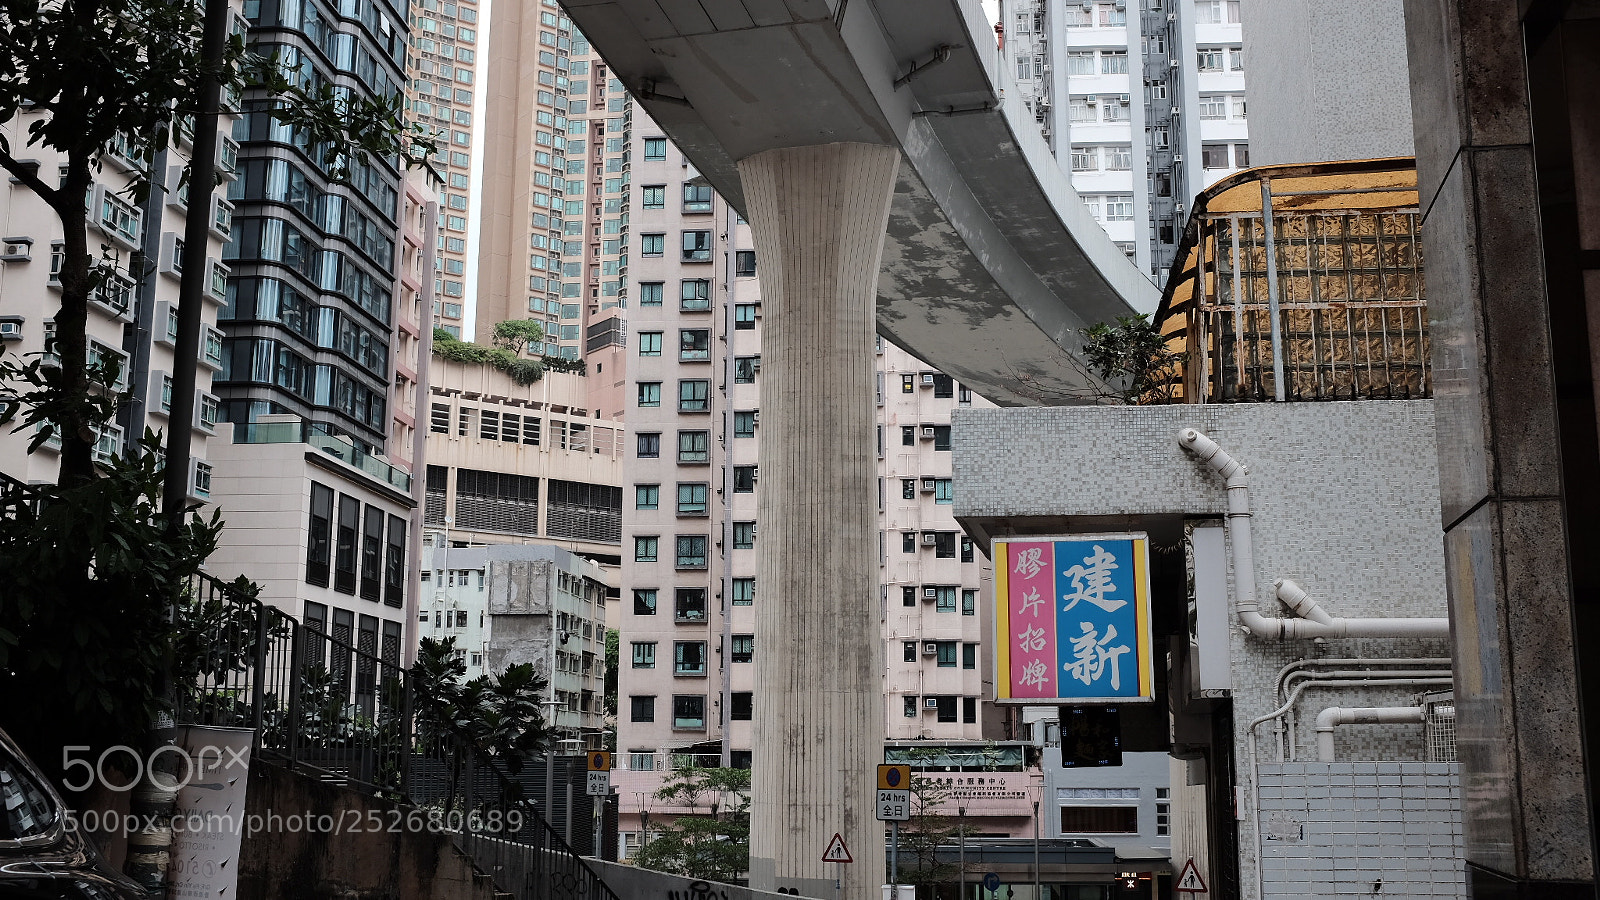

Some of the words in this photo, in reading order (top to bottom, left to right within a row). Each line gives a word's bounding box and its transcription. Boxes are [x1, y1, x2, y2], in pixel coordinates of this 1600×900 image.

[1014, 547, 1049, 692] 膠片招牌
[1062, 545, 1130, 691] 建新
[590, 783, 603, 792] 全日
[880, 793, 892, 802] 24
[893, 793, 906, 802] hrs
[883, 805, 903, 817] 全日
